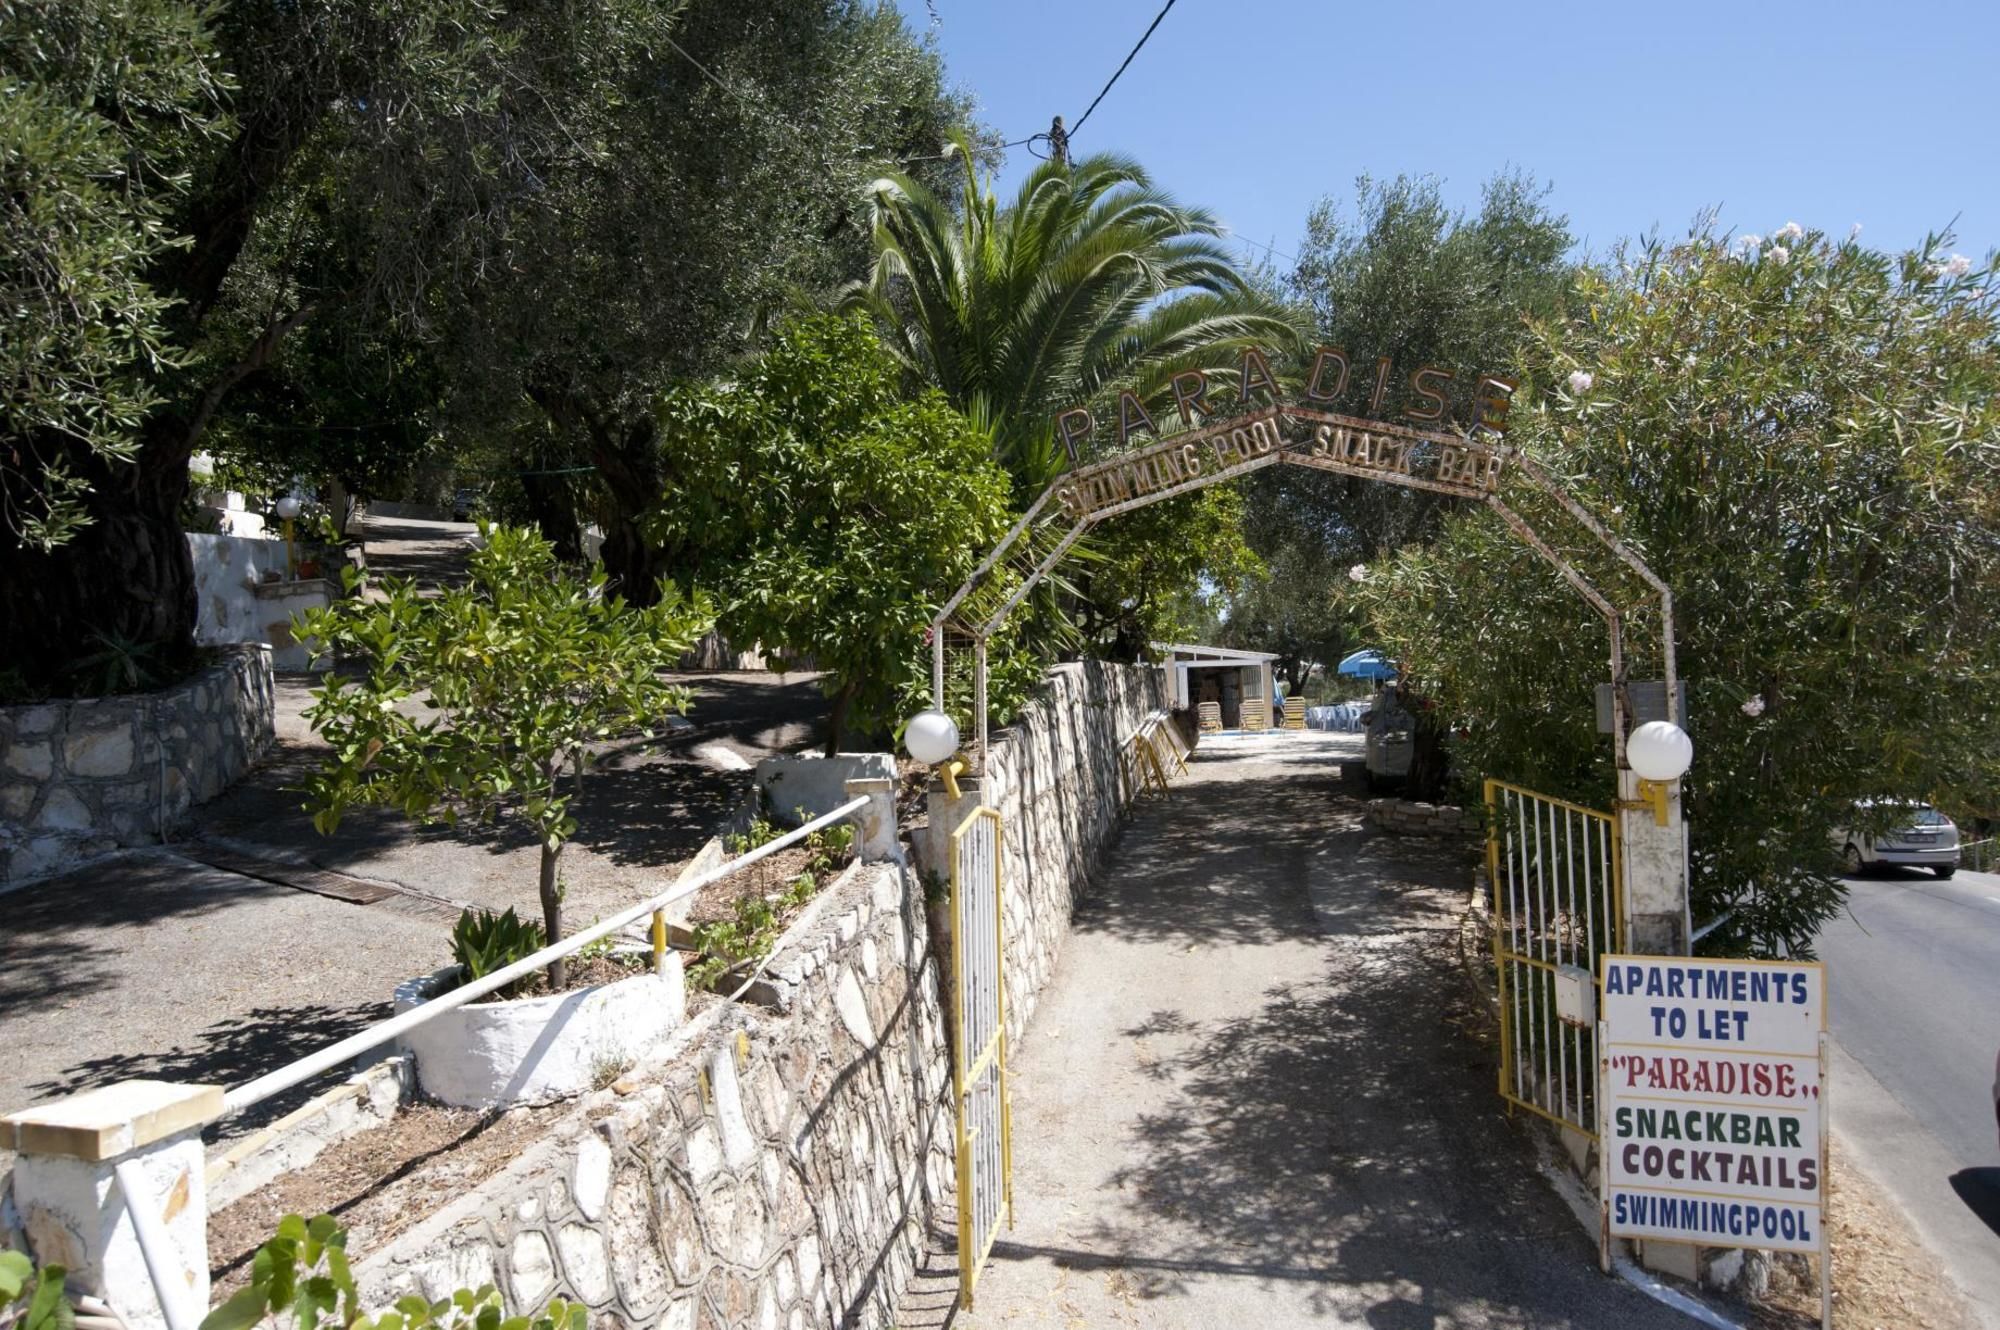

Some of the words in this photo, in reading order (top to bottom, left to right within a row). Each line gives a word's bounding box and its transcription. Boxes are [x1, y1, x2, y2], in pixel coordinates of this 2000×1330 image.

[1055, 345, 1519, 462] PARADISE
[1211, 417, 1293, 468] POOL
[1312, 425, 1414, 476] SNACK
[1437, 449, 1504, 491] BAR
[1606, 964, 1807, 1004] APARTMENTS
[1651, 1006, 1687, 1039] TO
[1698, 1009, 1749, 1041] LET
[1615, 1106, 1802, 1148] SNACKBAR
[1622, 1143, 1817, 1191] COCKTAILS
[1615, 1193, 1811, 1242] SWIMMINGPOOL
